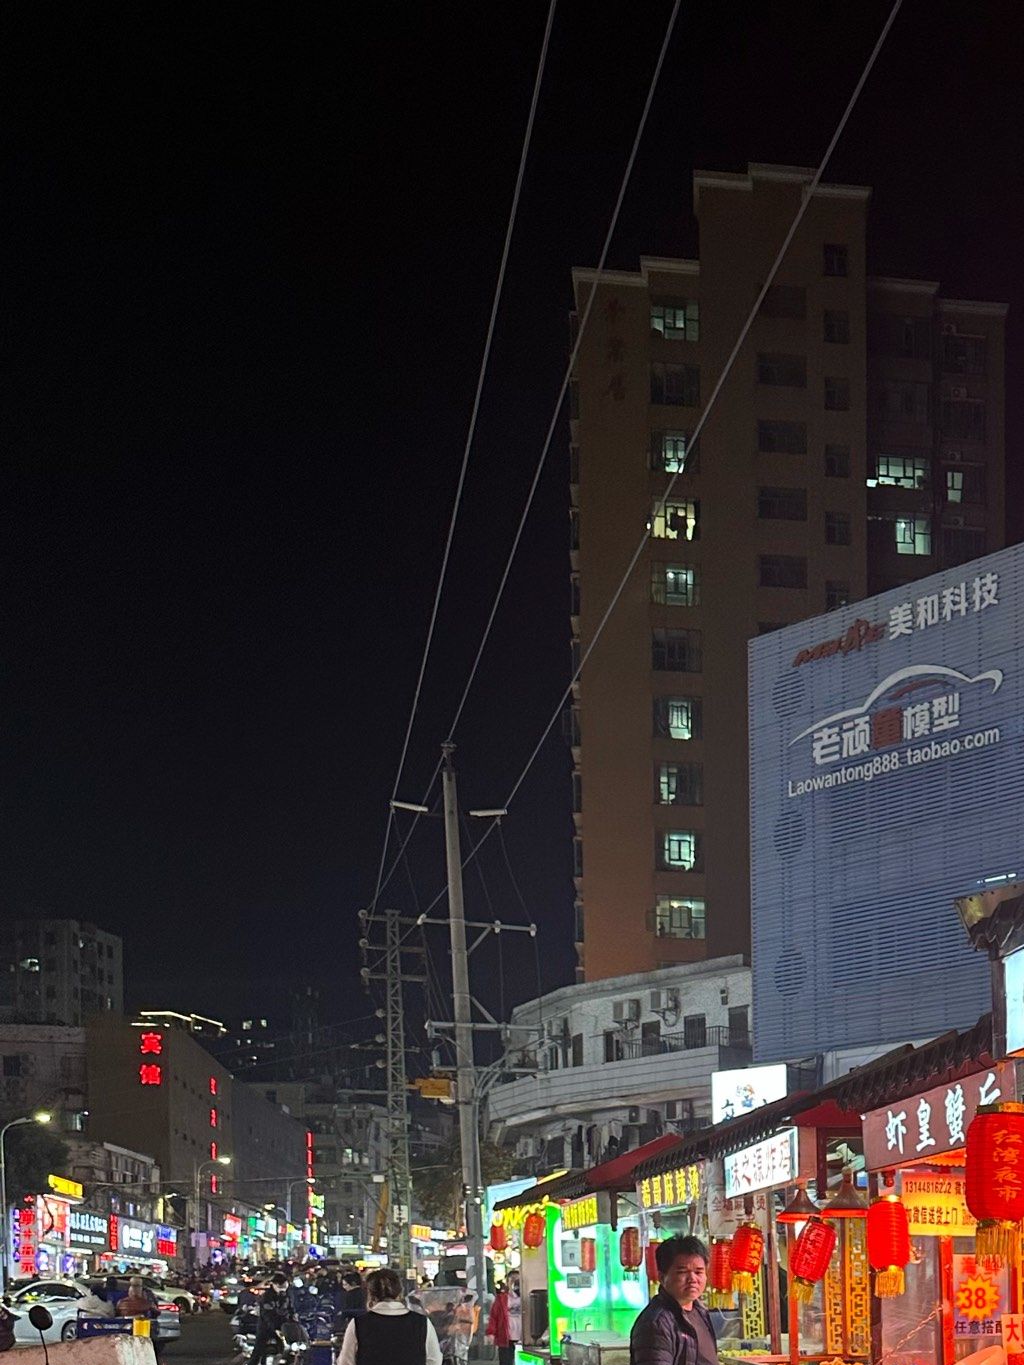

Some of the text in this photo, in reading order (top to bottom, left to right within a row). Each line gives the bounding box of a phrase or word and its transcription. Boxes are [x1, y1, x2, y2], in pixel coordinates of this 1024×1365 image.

[888, 572, 999, 641] 美和科技
[960, 1287, 986, 1310] 38
